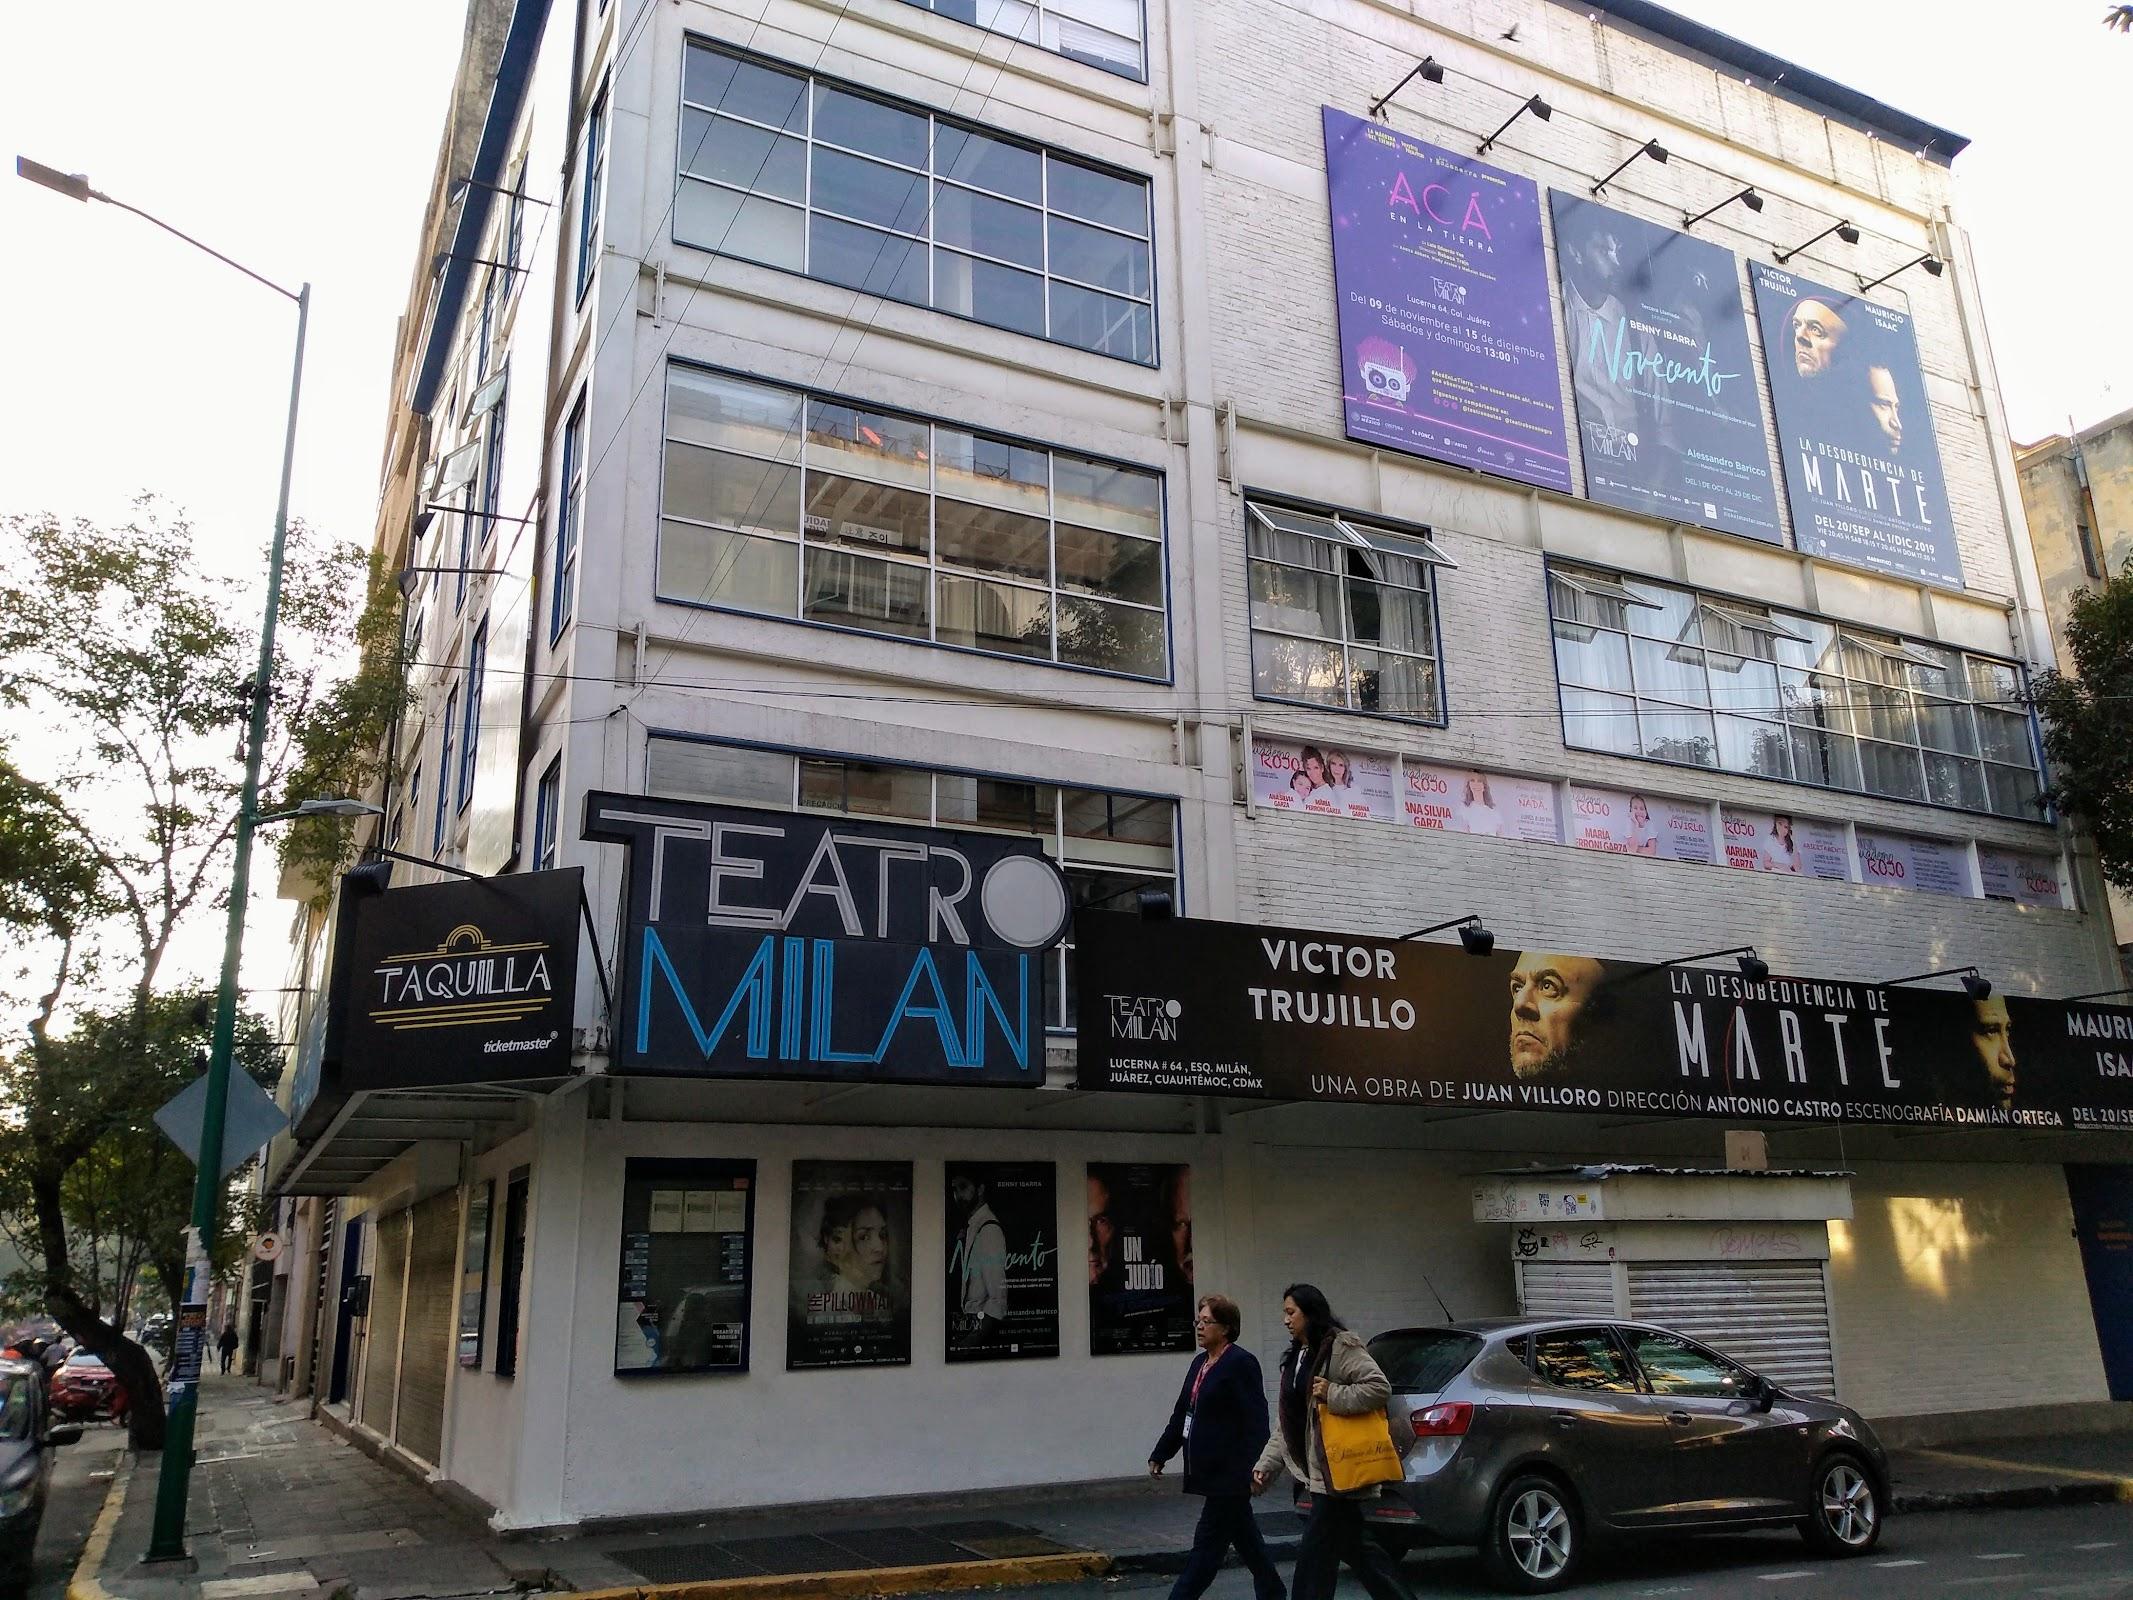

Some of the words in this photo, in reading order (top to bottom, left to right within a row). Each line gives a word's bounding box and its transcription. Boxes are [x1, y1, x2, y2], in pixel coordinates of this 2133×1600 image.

[1389, 171, 1492, 240] ACÁ
[1390, 212, 1407, 225] EN
[1417, 221, 1433, 233] LA
[1443, 230, 1494, 254] TIERRA
[1429, 276, 1466, 295] TEATRO
[1759, 277, 1797, 298] TRUJILLO
[1760, 267, 1791, 285] VICTOR
[1434, 288, 1465, 305] MILAN
[1406, 294, 1436, 310] Lucerna
[1466, 311, 1491, 328] Juárez
[1864, 304, 1904, 324] MAURICIO
[1350, 292, 1366, 305] Del
[1369, 297, 1382, 310] 09
[1385, 302, 1397, 314] de
[1400, 307, 1450, 332] noviembre
[1452, 323, 1462, 335] al
[1465, 328, 1478, 340] 15
[1481, 332, 1494, 345] de
[1496, 335, 1545, 361] diciembre
[1630, 320, 1661, 337] BENNY
[1663, 330, 1697, 348] IBARRA
[1875, 318, 1898, 333] ISAAC
[1381, 314, 1424, 337] Sábados
[1426, 329, 1432, 342] y
[1435, 331, 1481, 355] domingos
[1483, 347, 1511, 362] 13:00
[1513, 353, 1519, 365] h
[1589, 316, 1741, 397] Novecento
[1585, 420, 1638, 446] TEATRO
[1591, 436, 1637, 462] MILAN
[1799, 437, 1812, 452] LA
[1819, 442, 1905, 478] DESOBEDIENCIA
[1911, 468, 1925, 484] DE
[1687, 448, 1733, 469] Alessandro
[1735, 460, 1767, 478] Baricco
[1685, 477, 1697, 486] DEL
[1702, 480, 1710, 489] DE
[1711, 483, 1724, 493] OCT
[1801, 452, 1932, 525] MARTE
[1814, 514, 1834, 529] DEL
[1836, 520, 1870, 537] 20/SEP
[1873, 532, 1885, 542] AL
[1886, 533, 1913, 549] 1/DIC
[1914, 540, 1935, 554] 2019
[1816, 527, 1827, 535] VIE
[1903, 548, 1916, 558] DOM
[1261, 755, 1300, 772] ROJO
[1410, 776, 1448, 793] ROJO
[1576, 800, 1610, 816] ROJO
[1413, 816, 1443, 829] GARZA
[1667, 819, 1706, 833] VIVIRLO.
[1724, 821, 1755, 837] ROJO
[1603, 841, 1628, 852] GARZA
[1725, 845, 1758, 860] MARIANA
[1730, 858, 1754, 869] GARZA
[1867, 858, 1905, 878] ROJO
[600, 809, 1067, 948] TEATRO
[2025, 877, 2057, 895] ROJO
[1261, 938, 1397, 980] VICTOR
[374, 952, 552, 1004] TAQUILLA
[637, 926, 1028, 1070] MILAN
[1670, 971, 1693, 995] LA
[1705, 974, 1856, 1010] DESOBEDIENCIA
[1867, 990, 1889, 1012] DE
[1103, 994, 1182, 1019] TEATRO
[1248, 987, 1416, 1031] TRUJILLO
[1111, 1015, 1177, 1041] MILAN
[1673, 1000, 1901, 1088] MARTE
[1109, 1058, 1160, 1070] LUCERNA
[1161, 1061, 1168, 1070] #
[1190, 1062, 1213, 1075] ESQ.
[1215, 1061, 1252, 1076] MILÁN,
[1109, 1071, 1152, 1086] JUÁREZ,
[1154, 1074, 1231, 1088] CUAUHTÉMOC,
[1232, 1077, 1263, 1089] CDMX
[1310, 1075, 1358, 1095] UNA
[1365, 1077, 1423, 1100] OBRA
[1429, 1081, 1456, 1100] DE
[1462, 1082, 1514, 1103] JUAN
[1519, 1085, 1601, 1107] VILLORO
[1607, 1089, 1702, 1112] DIRECCIÓN
[1706, 1095, 1779, 1115] ANTONIO
[1783, 1099, 1842, 1118] CASTRO
[1846, 1102, 1955, 1123] ESCENOGRAFÍA
[1956, 1105, 2010, 1125] DAMIÁN
[2012, 1109, 2063, 1126] ORTEGA
[2072, 1107, 2098, 1122] DEL
[1123, 1236, 1143, 1262] UN
[1124, 1258, 1164, 1290] JUDÍO
